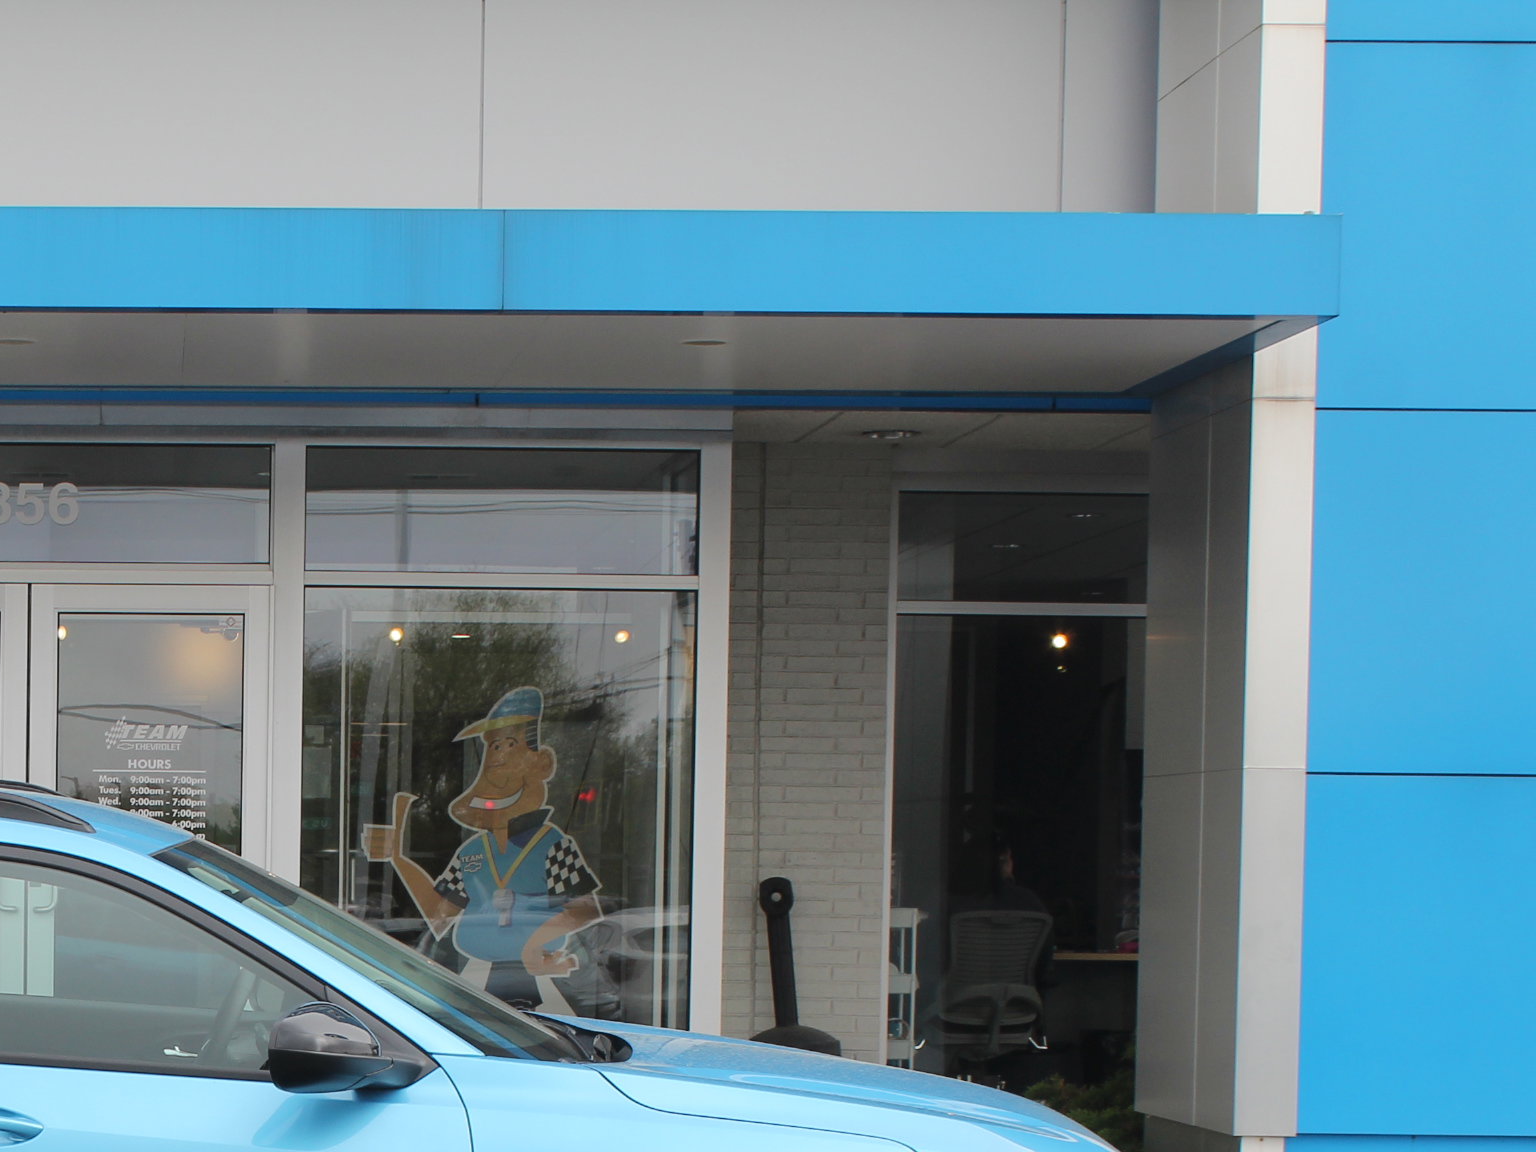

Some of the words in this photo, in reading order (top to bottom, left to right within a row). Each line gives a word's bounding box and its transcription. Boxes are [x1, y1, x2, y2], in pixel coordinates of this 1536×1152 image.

[120, 725, 188, 739] TEAM
[135, 743, 181, 751] CHEVROLET
[127, 759, 172, 769] HOURS
[98, 775, 122, 783] Mon.
[130, 776, 164, 784] 9:00am
[172, 777, 207, 785] 7:00pm
[99, 786, 122, 794] Tues.
[129, 787, 164, 795] 9:00am
[172, 787, 207, 797] 7:00pm
[98, 797, 122, 806] Wed.
[129, 798, 164, 806] 9:00am
[172, 798, 207, 808] 7:00pm
[172, 809, 206, 819] 7:00pm
[462, 854, 484, 862] TEAM
